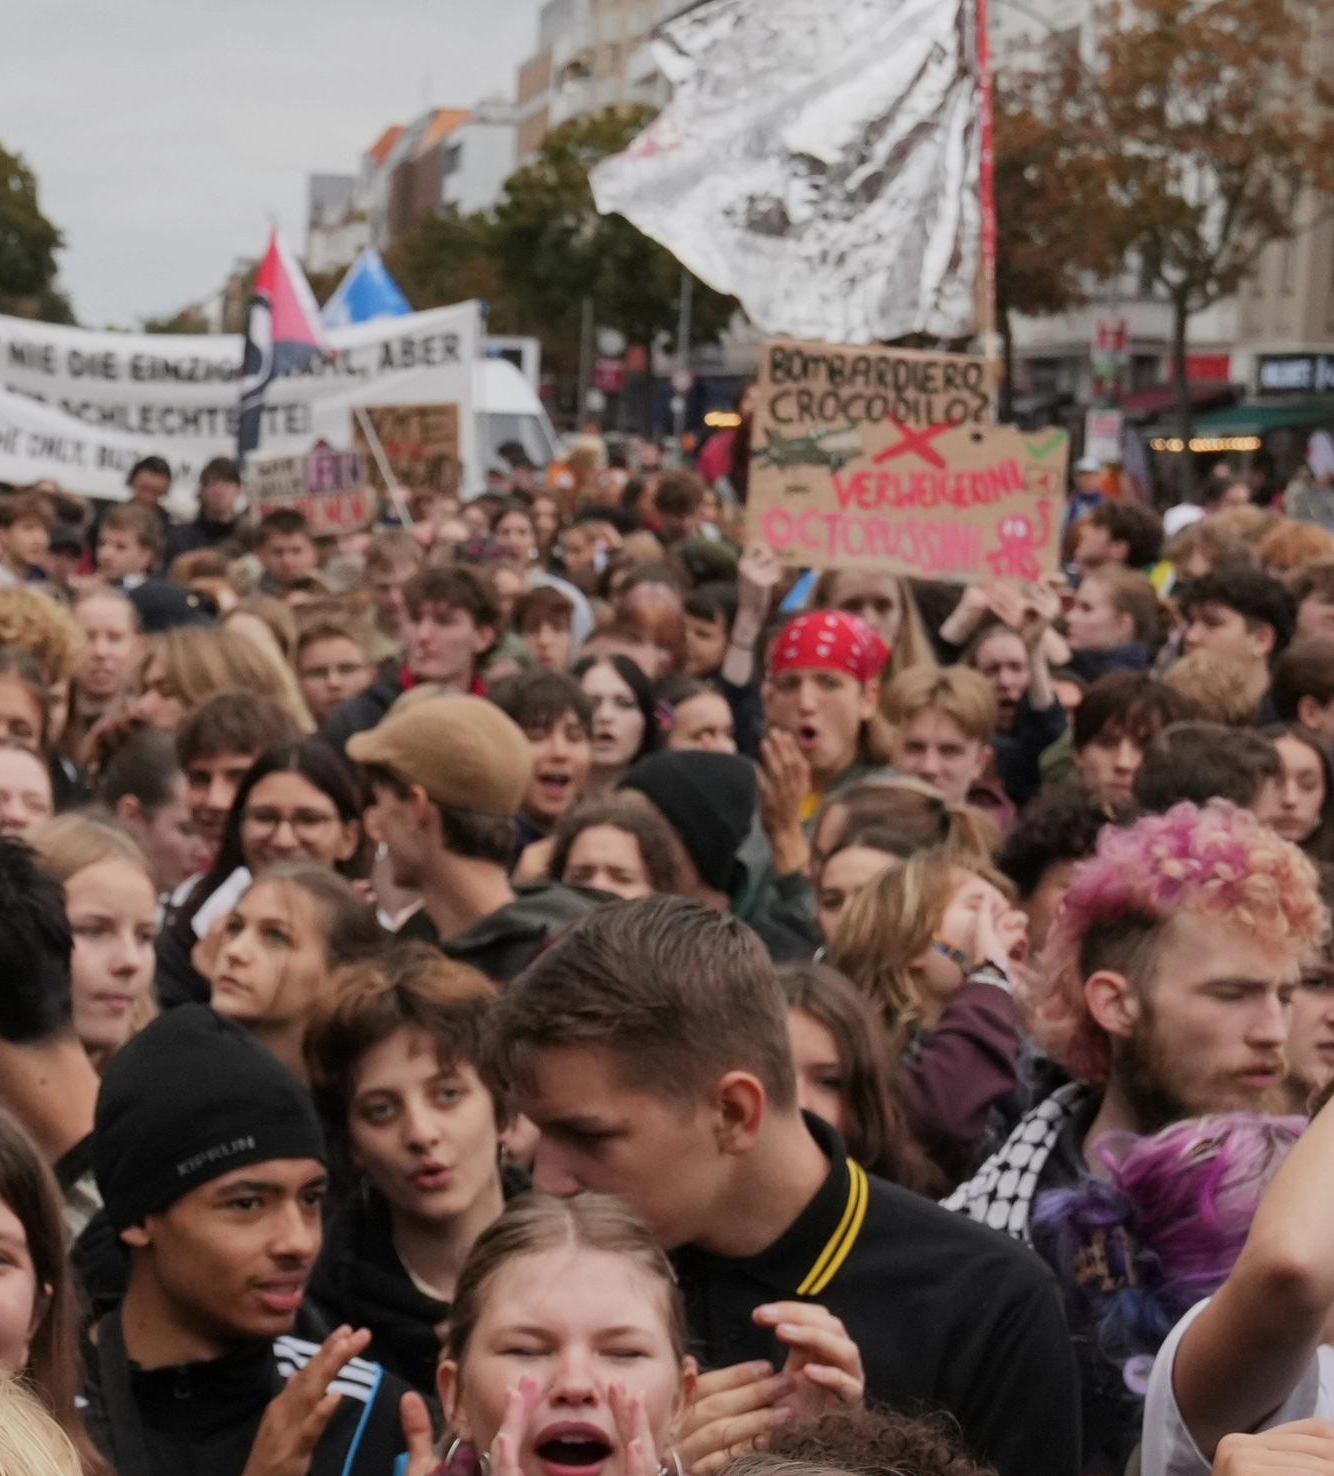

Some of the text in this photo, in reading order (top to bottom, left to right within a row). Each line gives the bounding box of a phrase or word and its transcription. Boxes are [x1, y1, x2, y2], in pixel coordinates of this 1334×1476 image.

[380, 333, 460, 371] ABER
[770, 389, 989, 442] CROCODILO?
[176, 1135, 256, 1177] KIPRUN
